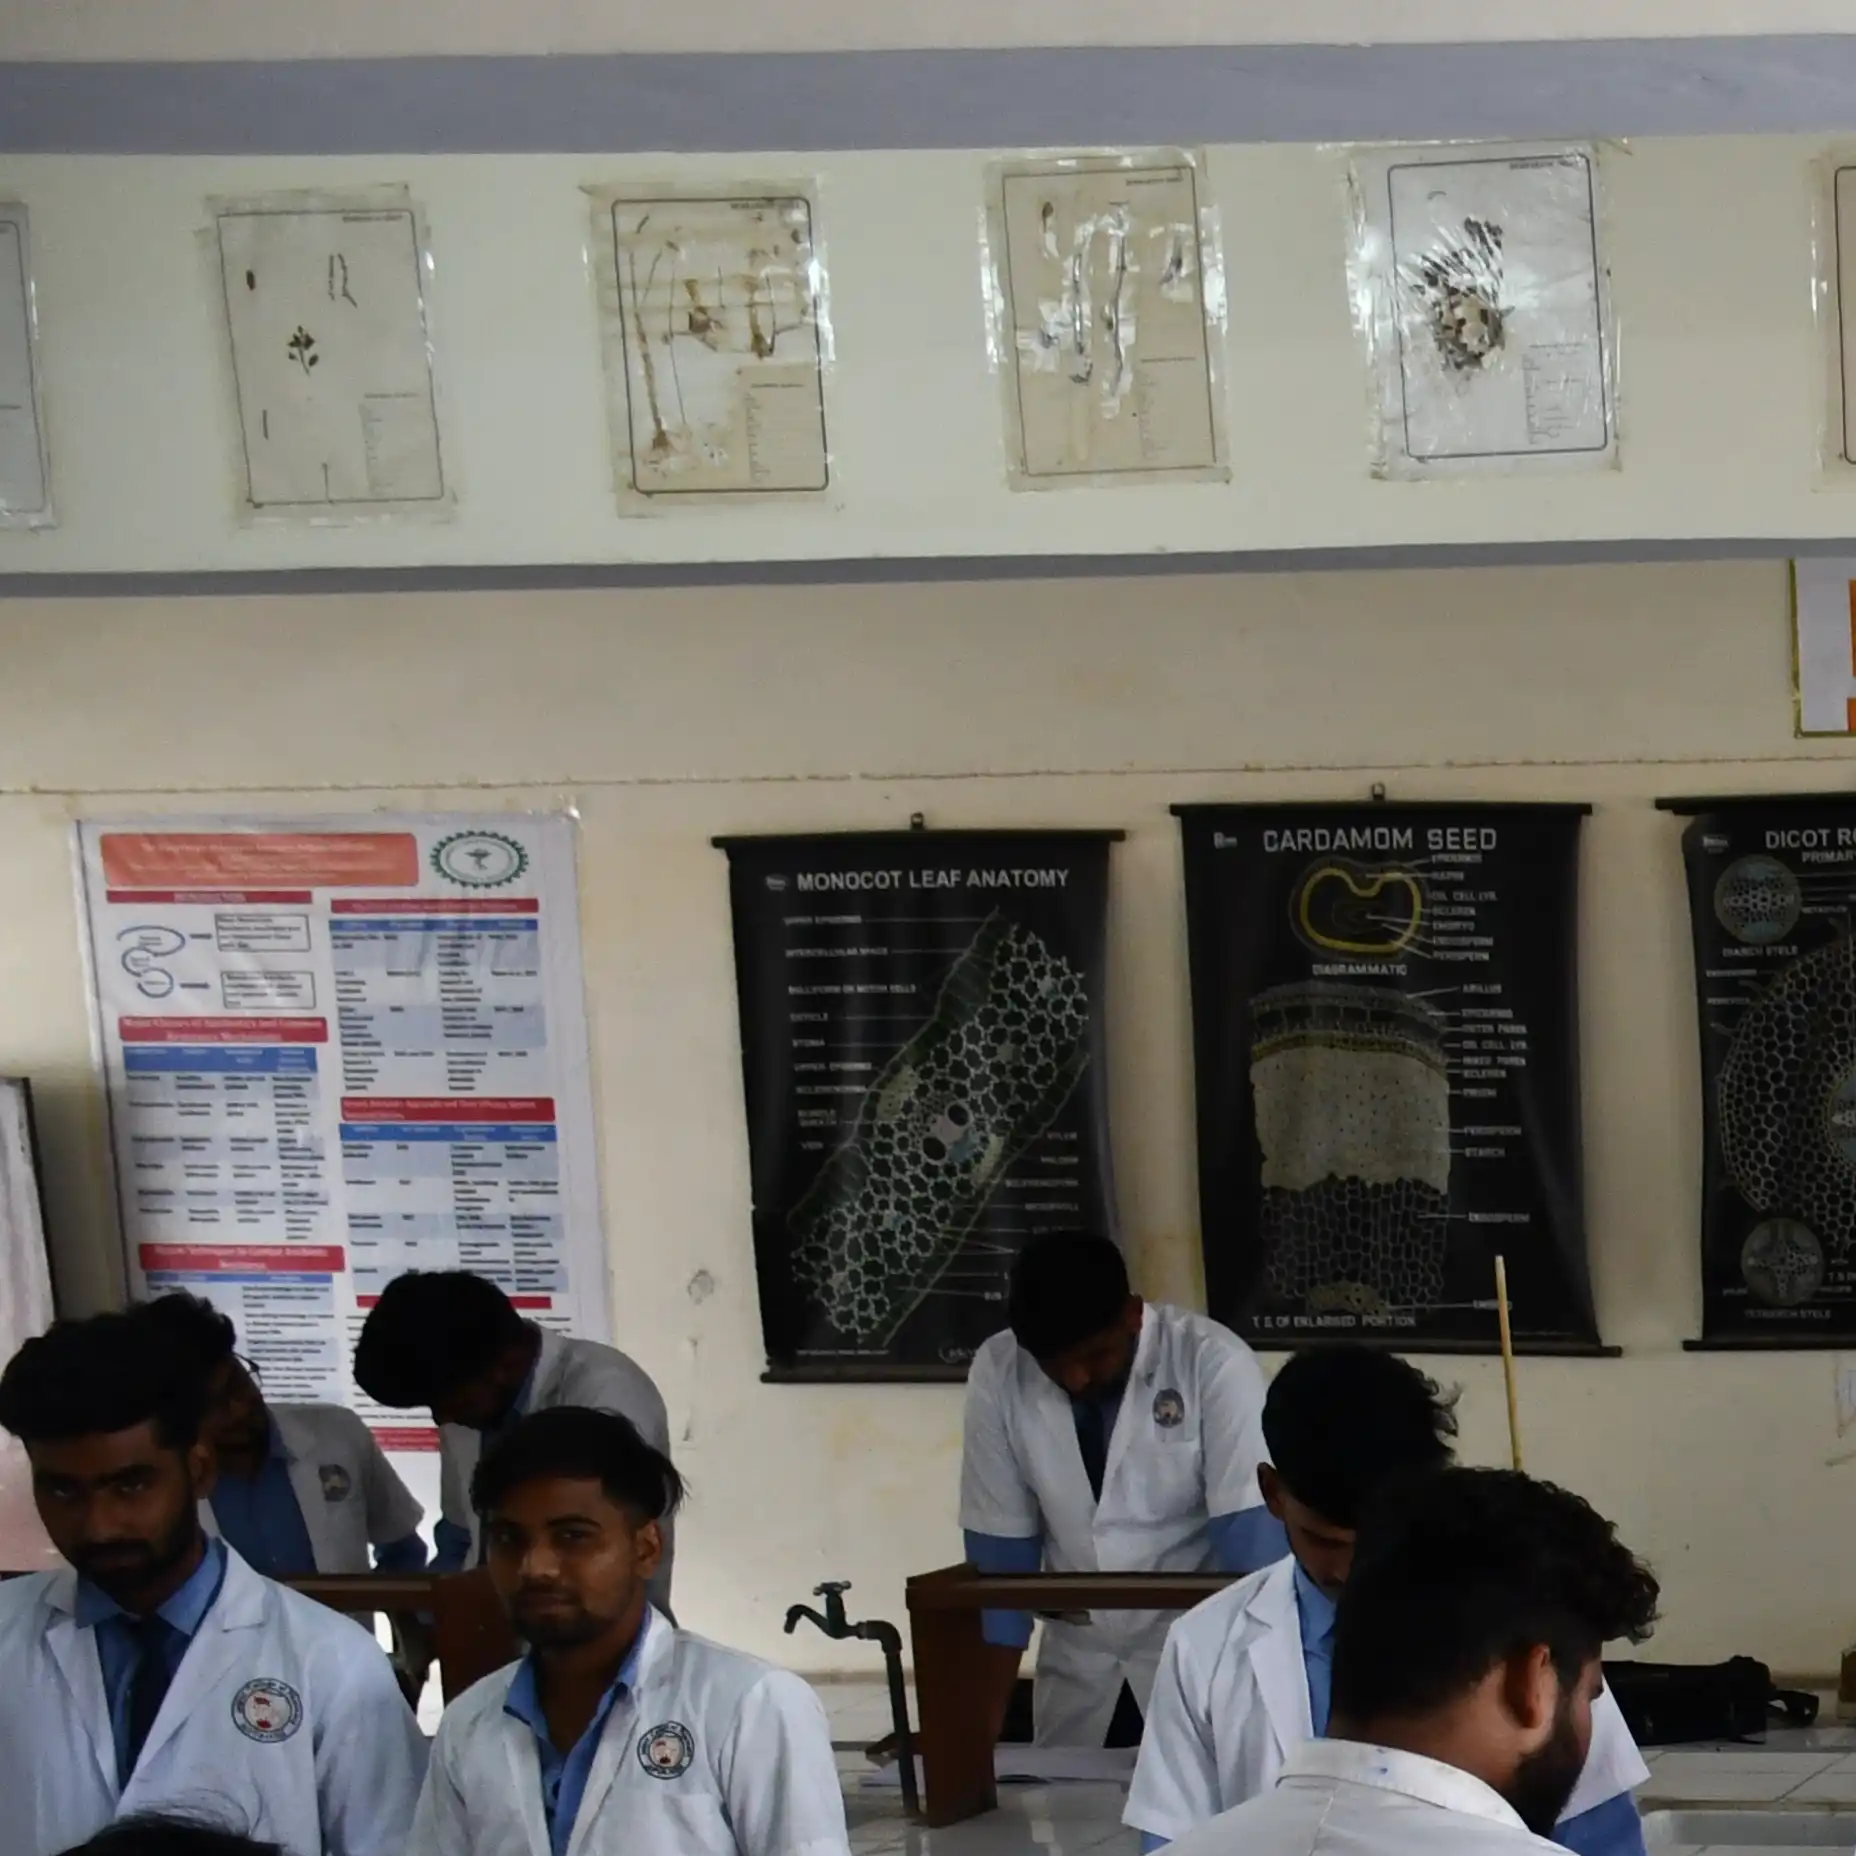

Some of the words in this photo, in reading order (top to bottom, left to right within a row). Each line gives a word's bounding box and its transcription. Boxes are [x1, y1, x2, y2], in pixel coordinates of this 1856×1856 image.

[1263, 828, 1414, 852] CARDAMOM
[1427, 827, 1498, 851] SEED
[1764, 829, 1830, 850] DICOT
[797, 870, 902, 891] MONOCOT
[909, 869, 962, 888] LEAF
[966, 868, 1070, 888] ANATOMY
